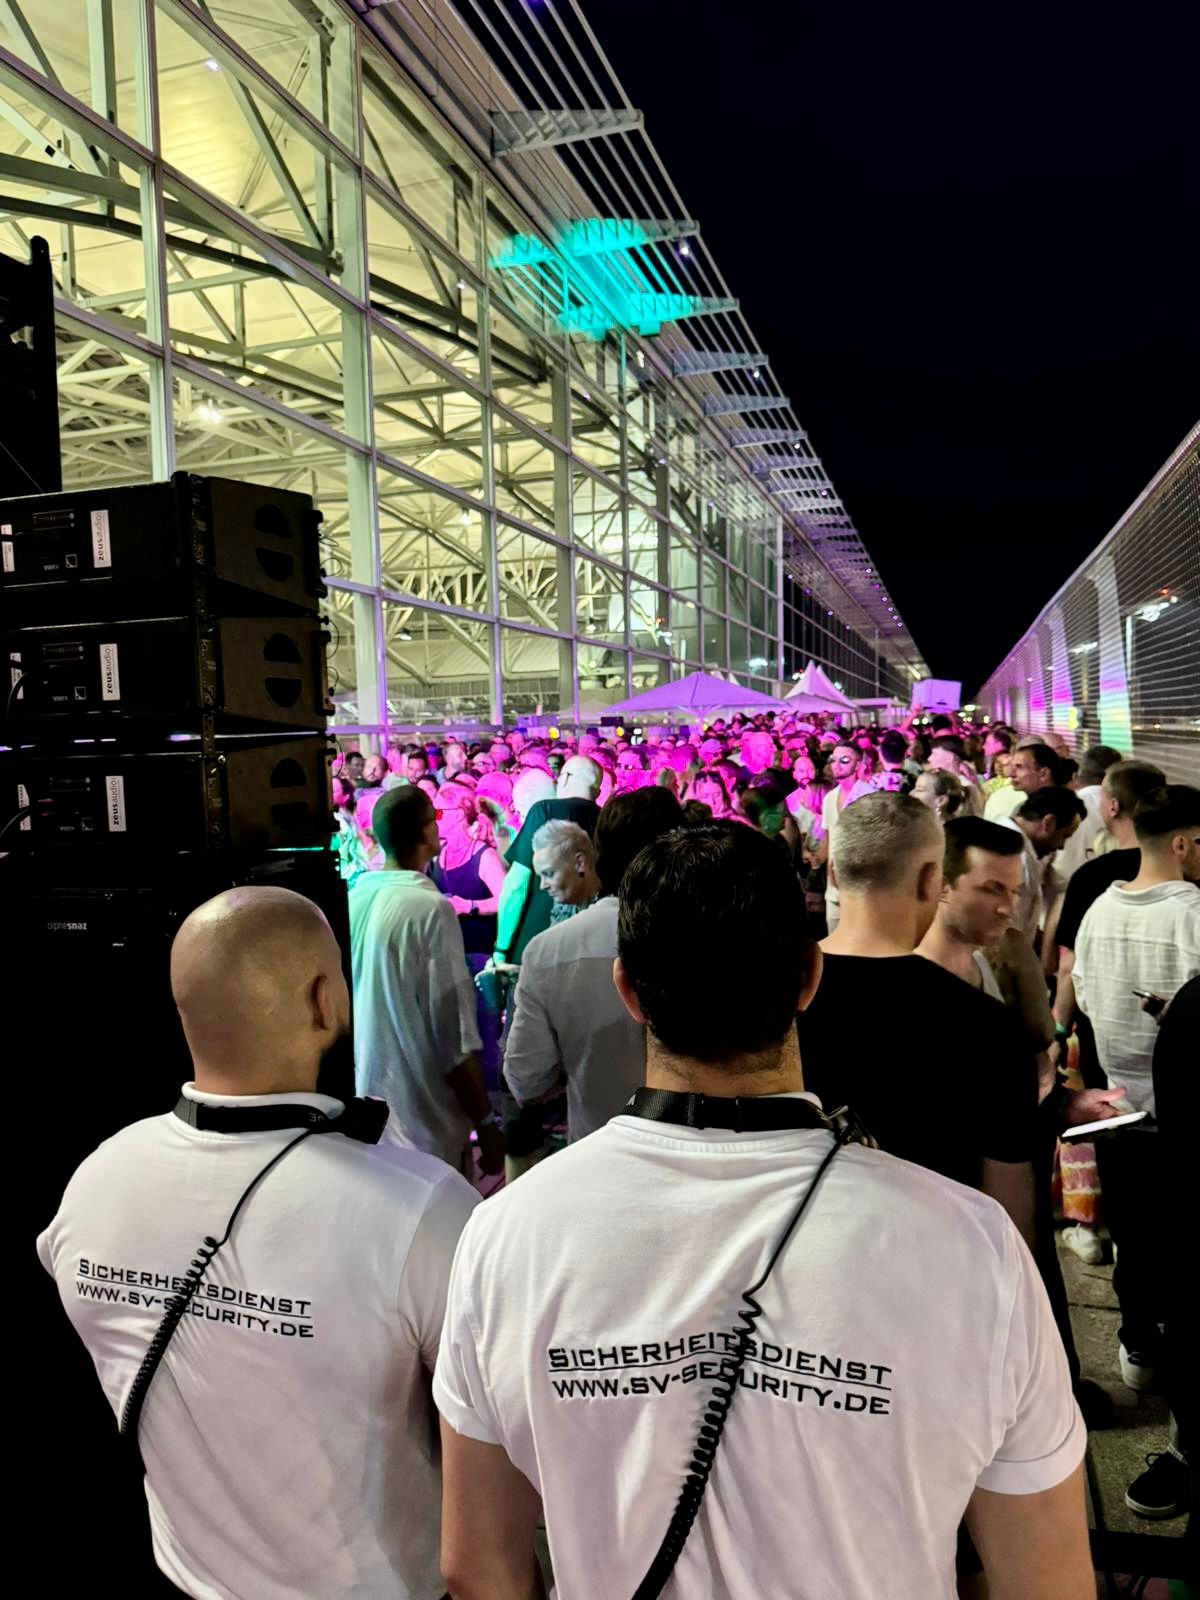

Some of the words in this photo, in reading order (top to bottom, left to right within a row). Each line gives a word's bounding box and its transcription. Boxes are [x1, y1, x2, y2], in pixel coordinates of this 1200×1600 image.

[104, 647, 113, 693] zeusaudio
[110, 779, 120, 825] zeusaudio
[79, 1258, 311, 1315] SICHERHETSDIENST
